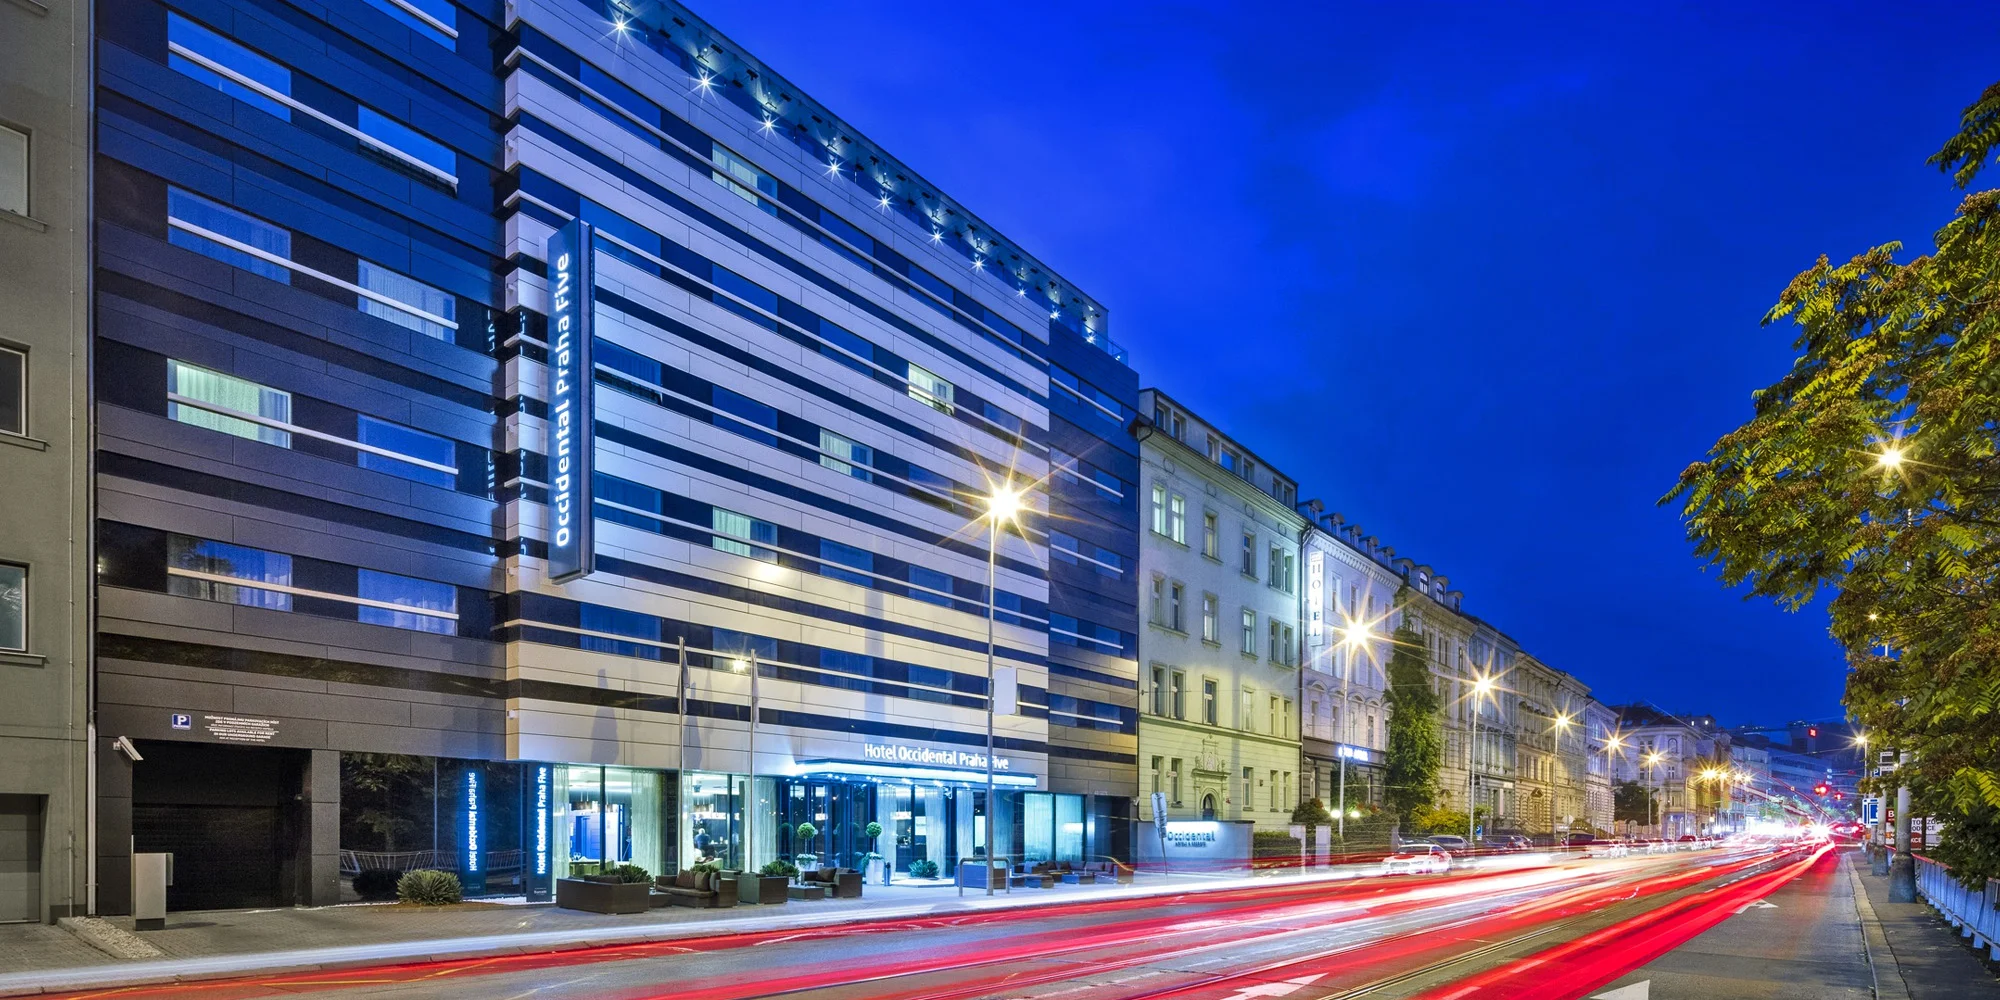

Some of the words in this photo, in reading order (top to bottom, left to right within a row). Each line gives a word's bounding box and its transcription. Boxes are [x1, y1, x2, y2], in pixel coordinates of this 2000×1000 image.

[554, 253, 569, 312] Five
[555, 315, 570, 395] Praha
[555, 399, 570, 547] Occidental
[864, 743, 897, 760] Hotel
[898, 746, 957, 765] Occidental
[959, 753, 987, 768] Praha
[537, 767, 547, 783] Five
[537, 784, 547, 807] Praha
[536, 808, 547, 852] Occidental
[1167, 830, 1216, 842] Occidental
[537, 852, 546, 874] Hotel
